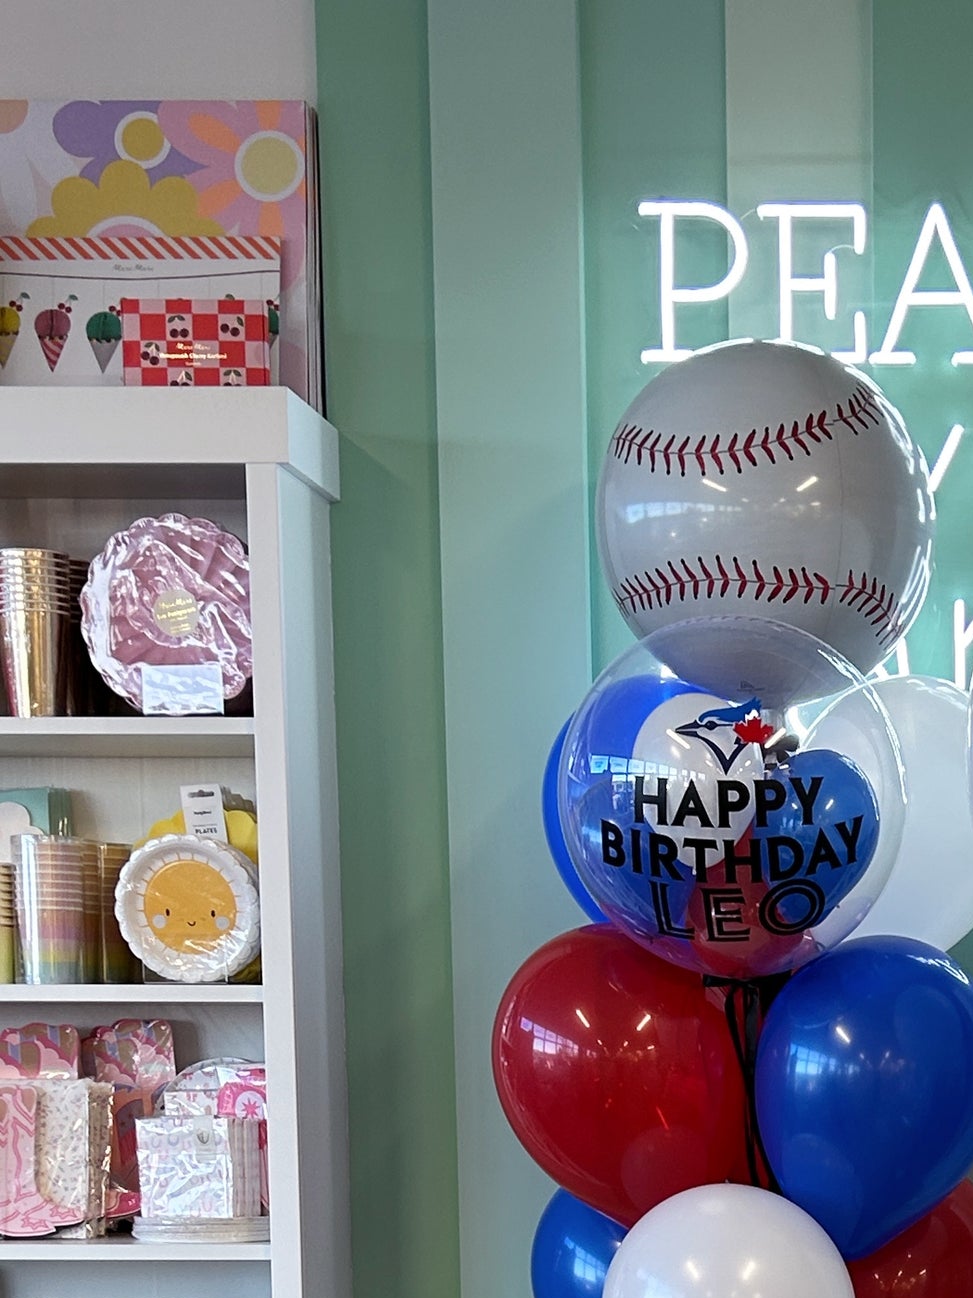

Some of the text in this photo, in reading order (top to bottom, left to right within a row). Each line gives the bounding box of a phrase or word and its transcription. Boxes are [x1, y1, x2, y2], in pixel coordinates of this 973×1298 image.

[633, 776, 824, 829] HAPPY
[601, 815, 864, 884] BIRTHDAY
[648, 878, 826, 942] LEO
